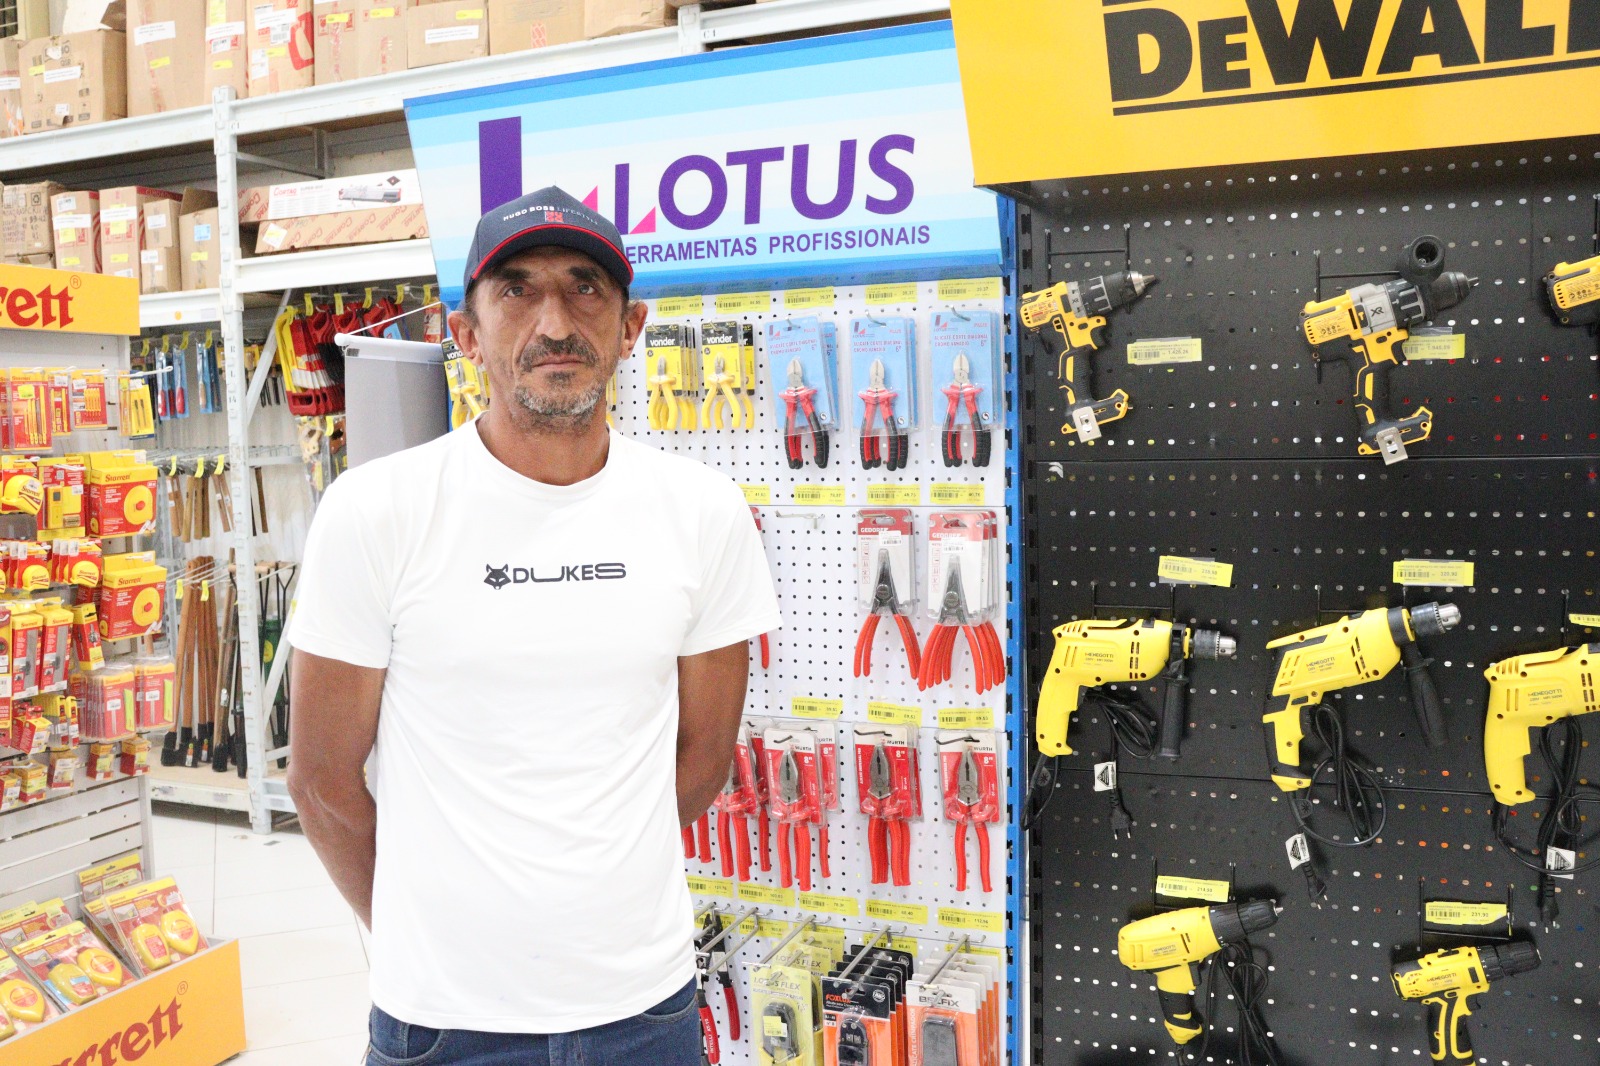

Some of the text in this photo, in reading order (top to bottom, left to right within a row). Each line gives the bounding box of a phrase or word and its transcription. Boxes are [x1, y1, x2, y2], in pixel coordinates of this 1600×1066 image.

[613, 134, 915, 235] LOTUS
[503, 209, 527, 222] HUGO
[626, 225, 931, 266] ERRAMENTAS PROFISSIONAIS
[650, 337, 675, 347] vonder
[707, 334, 733, 344] vonder
[512, 562, 627, 584] DUKES
[53, 996, 184, 1066] rrett
